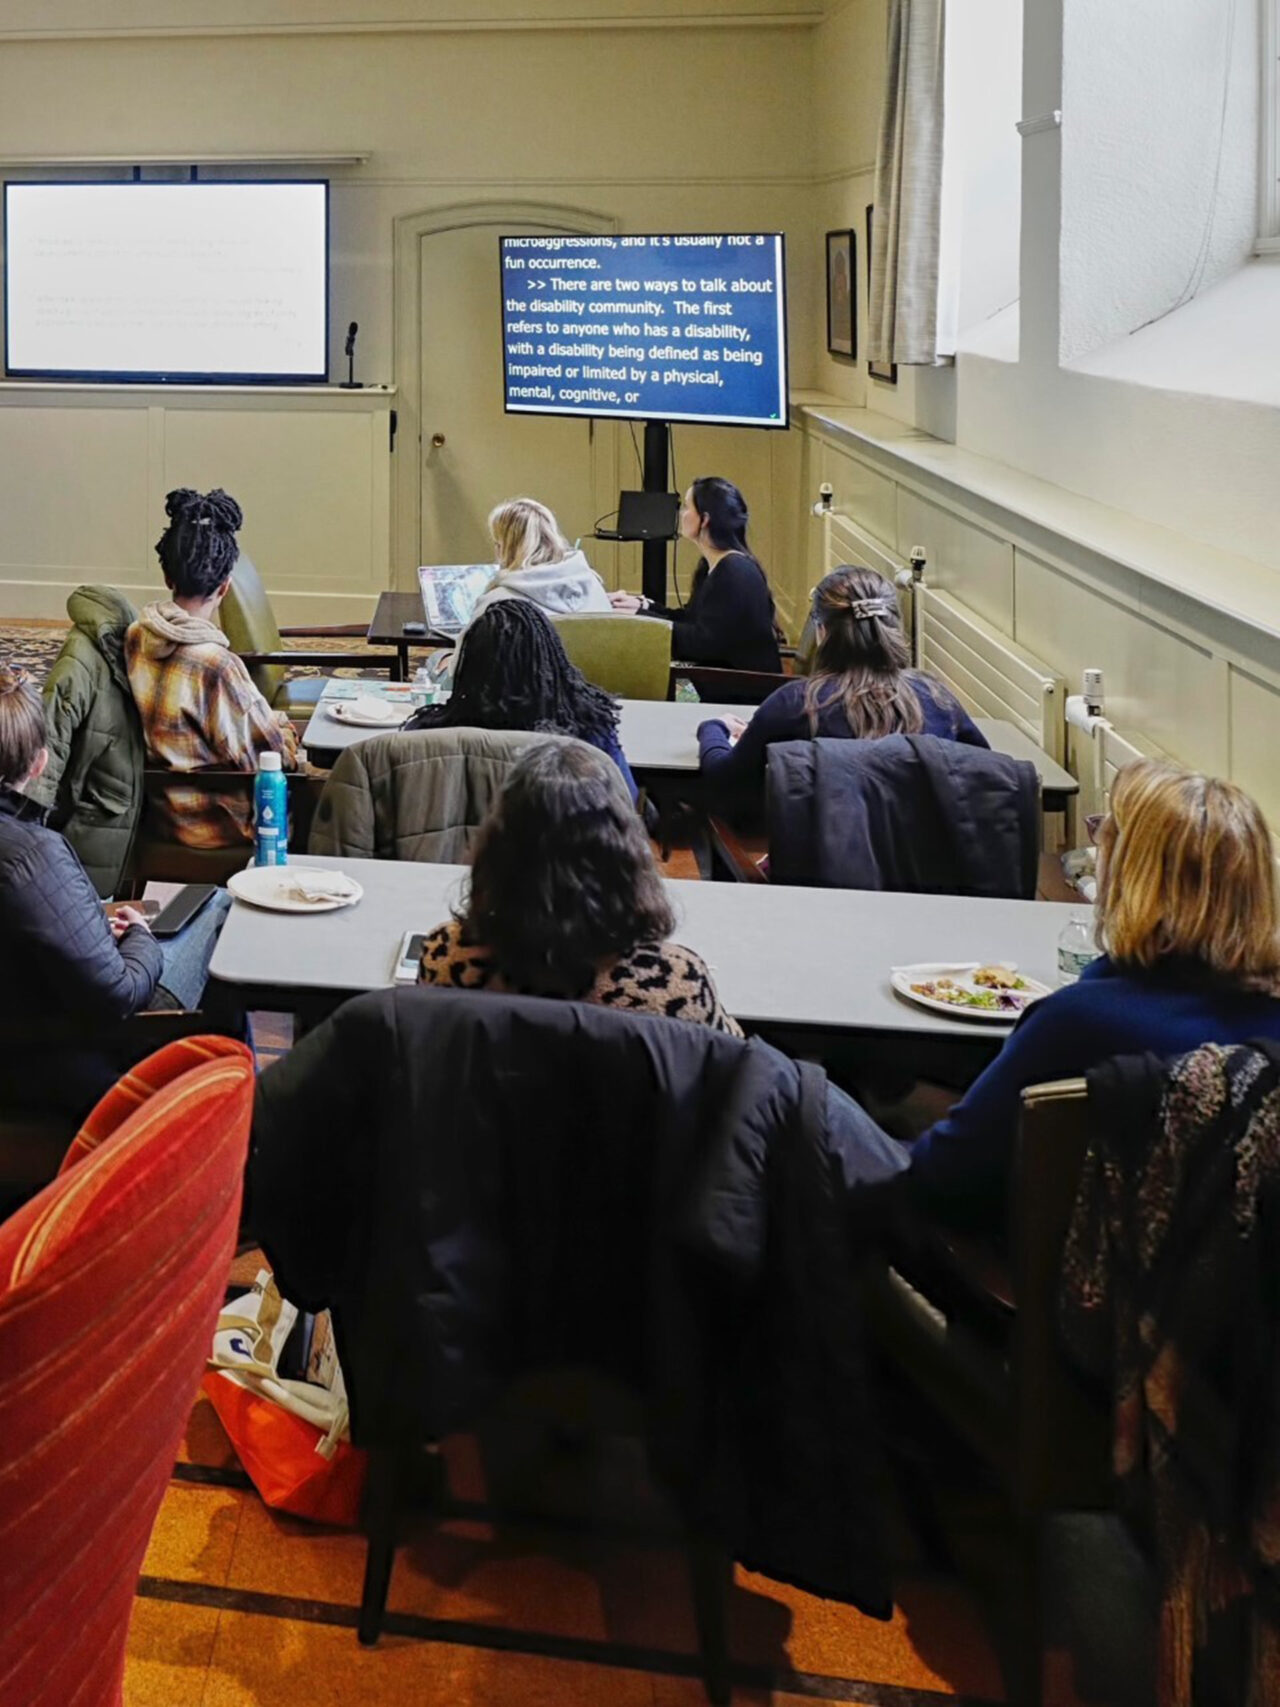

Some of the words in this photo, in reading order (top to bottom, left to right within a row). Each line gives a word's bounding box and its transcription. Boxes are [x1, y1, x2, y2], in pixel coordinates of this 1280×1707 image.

[755, 235, 765, 246] a
[505, 255, 525, 269] fun
[528, 258, 601, 269] occurrence.
[550, 277, 587, 291] There
[590, 280, 612, 291] are
[615, 278, 640, 291] two
[644, 280, 678, 295] ways
[682, 278, 696, 292] to
[700, 278, 727, 292] talk
[731, 278, 773, 293] about
[506, 299, 526, 311] the
[530, 299, 585, 315] disability
[589, 300, 665, 317] community.
[673, 301, 700, 315] The
[704, 301, 733, 315] first
[507, 321, 543, 334] refers
[546, 323, 559, 334] to
[562, 324, 609, 337] anyone
[613, 322, 640, 336] who
[644, 322, 668, 337] has
[672, 326, 681, 337] a
[685, 324, 751, 341] disability,
[507, 342, 533, 355] with
[537, 345, 545, 355] a
[548, 343, 604, 360] disability
[608, 344, 644, 361] being
[648, 346, 699, 360] defined
[703, 350, 719, 361] as
[723, 347, 763, 366] being
[508, 363, 562, 379] impaired
[565, 368, 579, 378] or
[582, 365, 626, 380] limited
[631, 367, 647, 384] by
[651, 371, 660, 382] a
[664, 368, 724, 387] physical,
[509, 385, 556, 401] mental,
[559, 388, 621, 404] cognitive,
[625, 392, 640, 403] or
